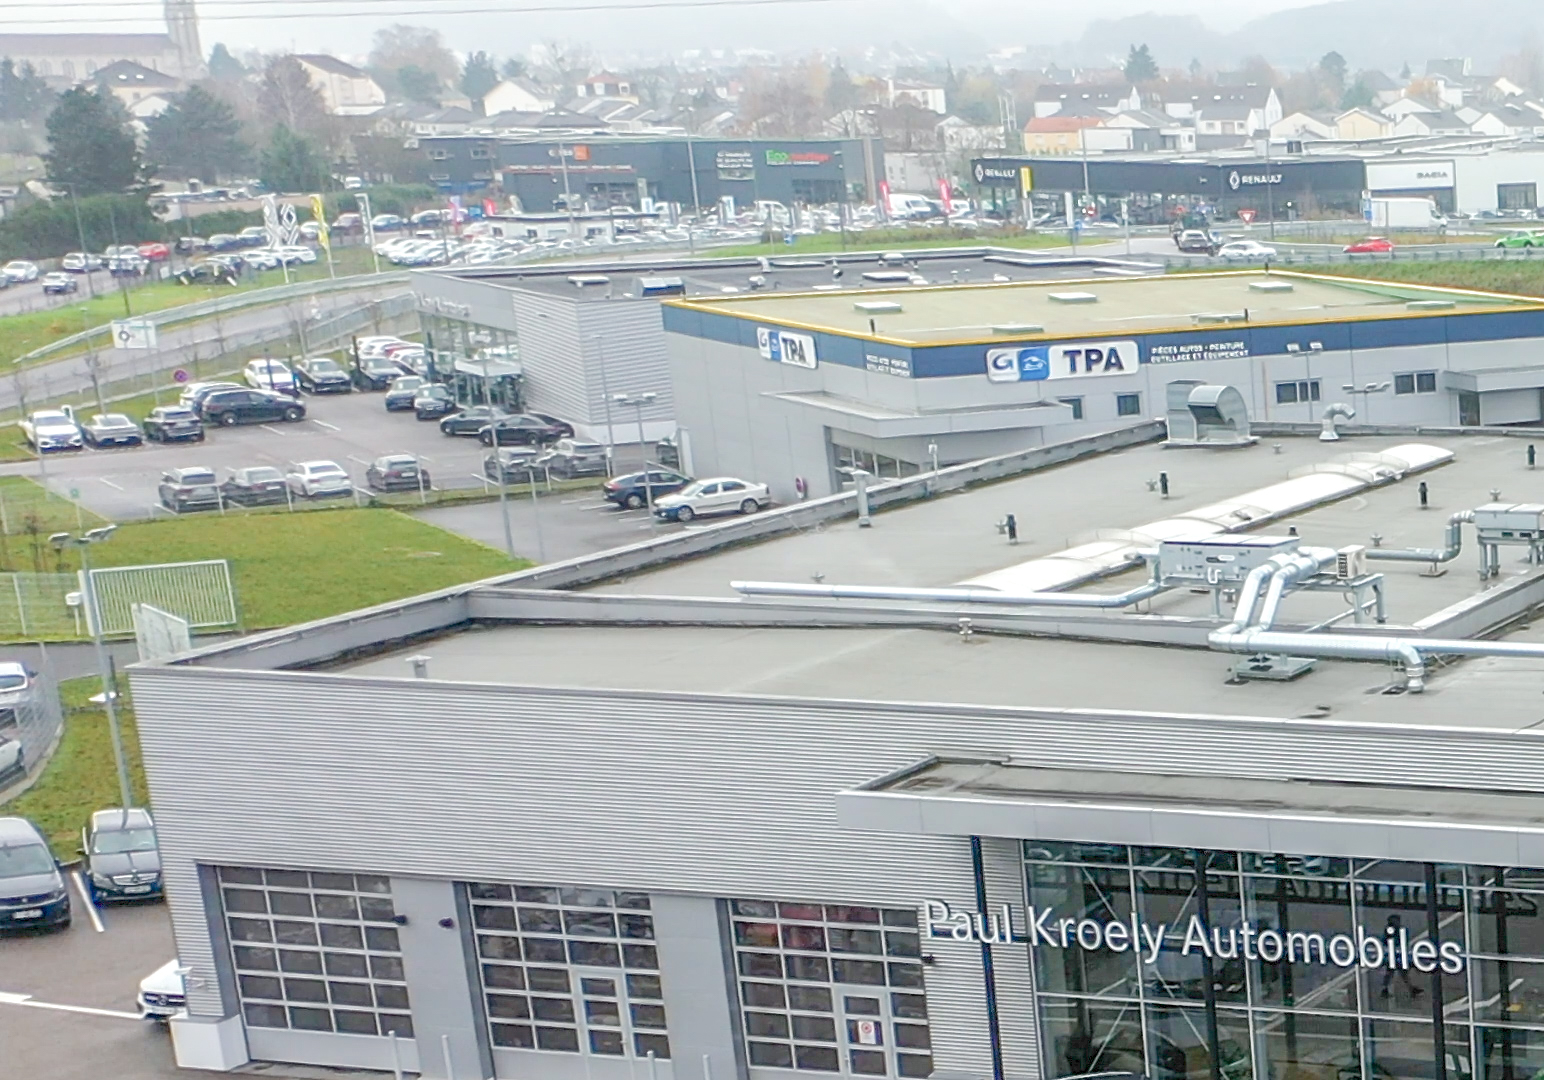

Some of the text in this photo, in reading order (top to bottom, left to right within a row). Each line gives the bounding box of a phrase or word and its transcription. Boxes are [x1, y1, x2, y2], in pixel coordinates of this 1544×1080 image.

[1241, 174, 1282, 185] RENAULT
[781, 337, 807, 364] TPA
[1062, 346, 1125, 374] TPA
[923, 899, 1465, 974] Paul Kroely Automobiles
